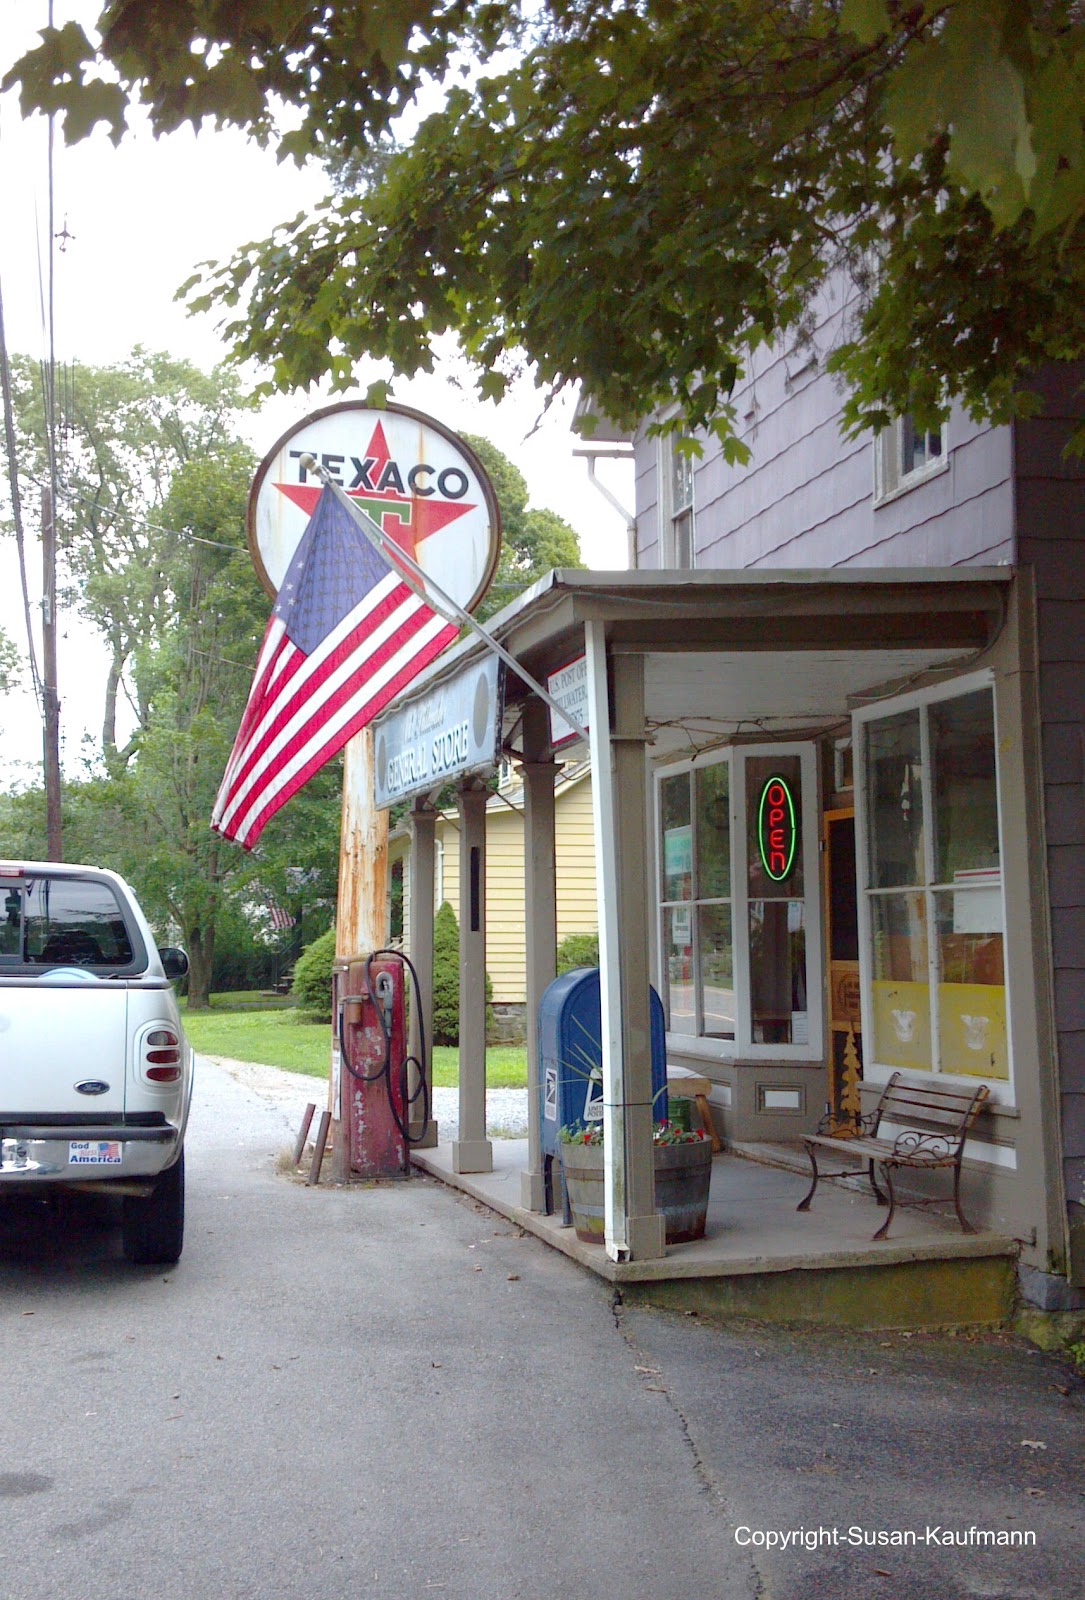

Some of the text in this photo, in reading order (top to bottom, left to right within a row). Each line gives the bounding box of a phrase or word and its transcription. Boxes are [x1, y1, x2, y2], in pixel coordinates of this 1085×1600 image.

[289, 450, 469, 500] TEXACO
[561, 668, 576, 689] POST
[576, 661, 587, 680] OFF
[387, 741, 428, 793] GENERAL
[431, 719, 469, 775] STORE
[70, 1142, 90, 1150] God
[70, 1155, 121, 1163] America
